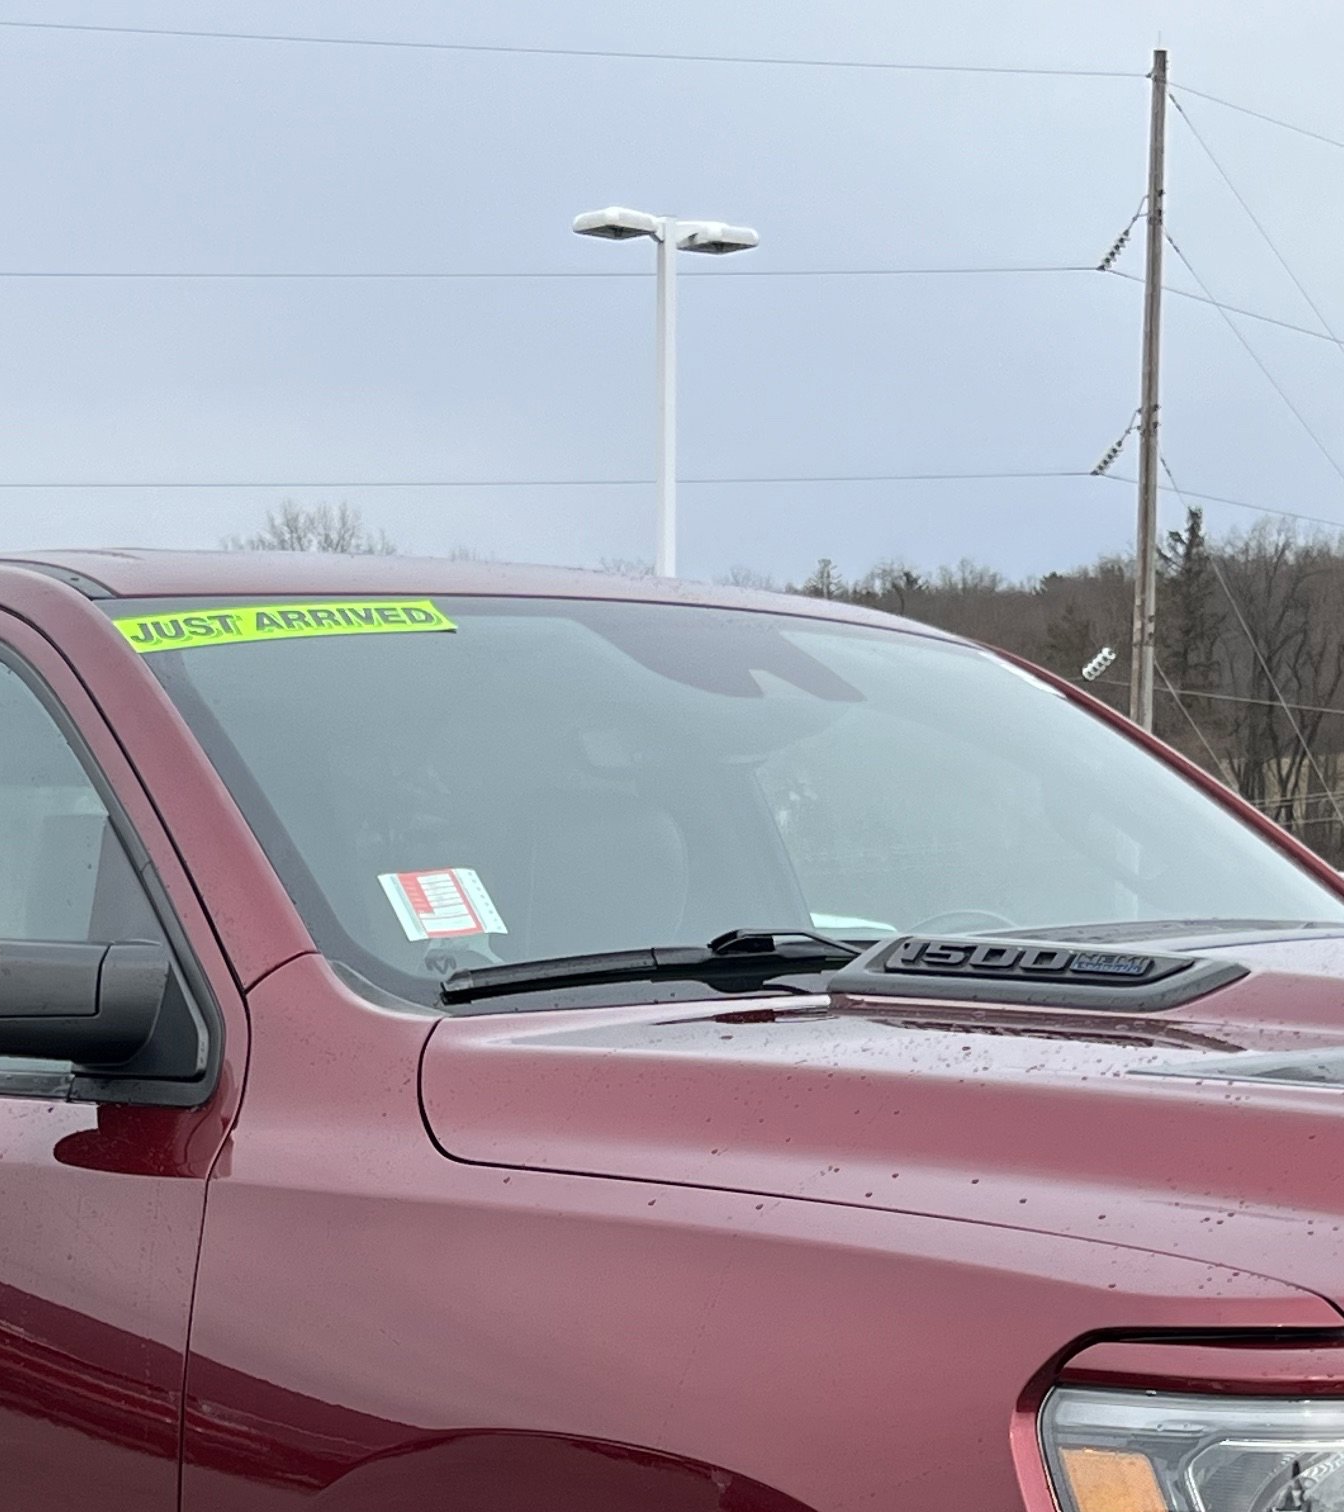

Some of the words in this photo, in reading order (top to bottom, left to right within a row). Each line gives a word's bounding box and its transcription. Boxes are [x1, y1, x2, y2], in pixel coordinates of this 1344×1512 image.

[131, 613, 240, 644] JUST
[256, 606, 440, 632] ARRIVED
[900, 940, 1070, 971] 1500
